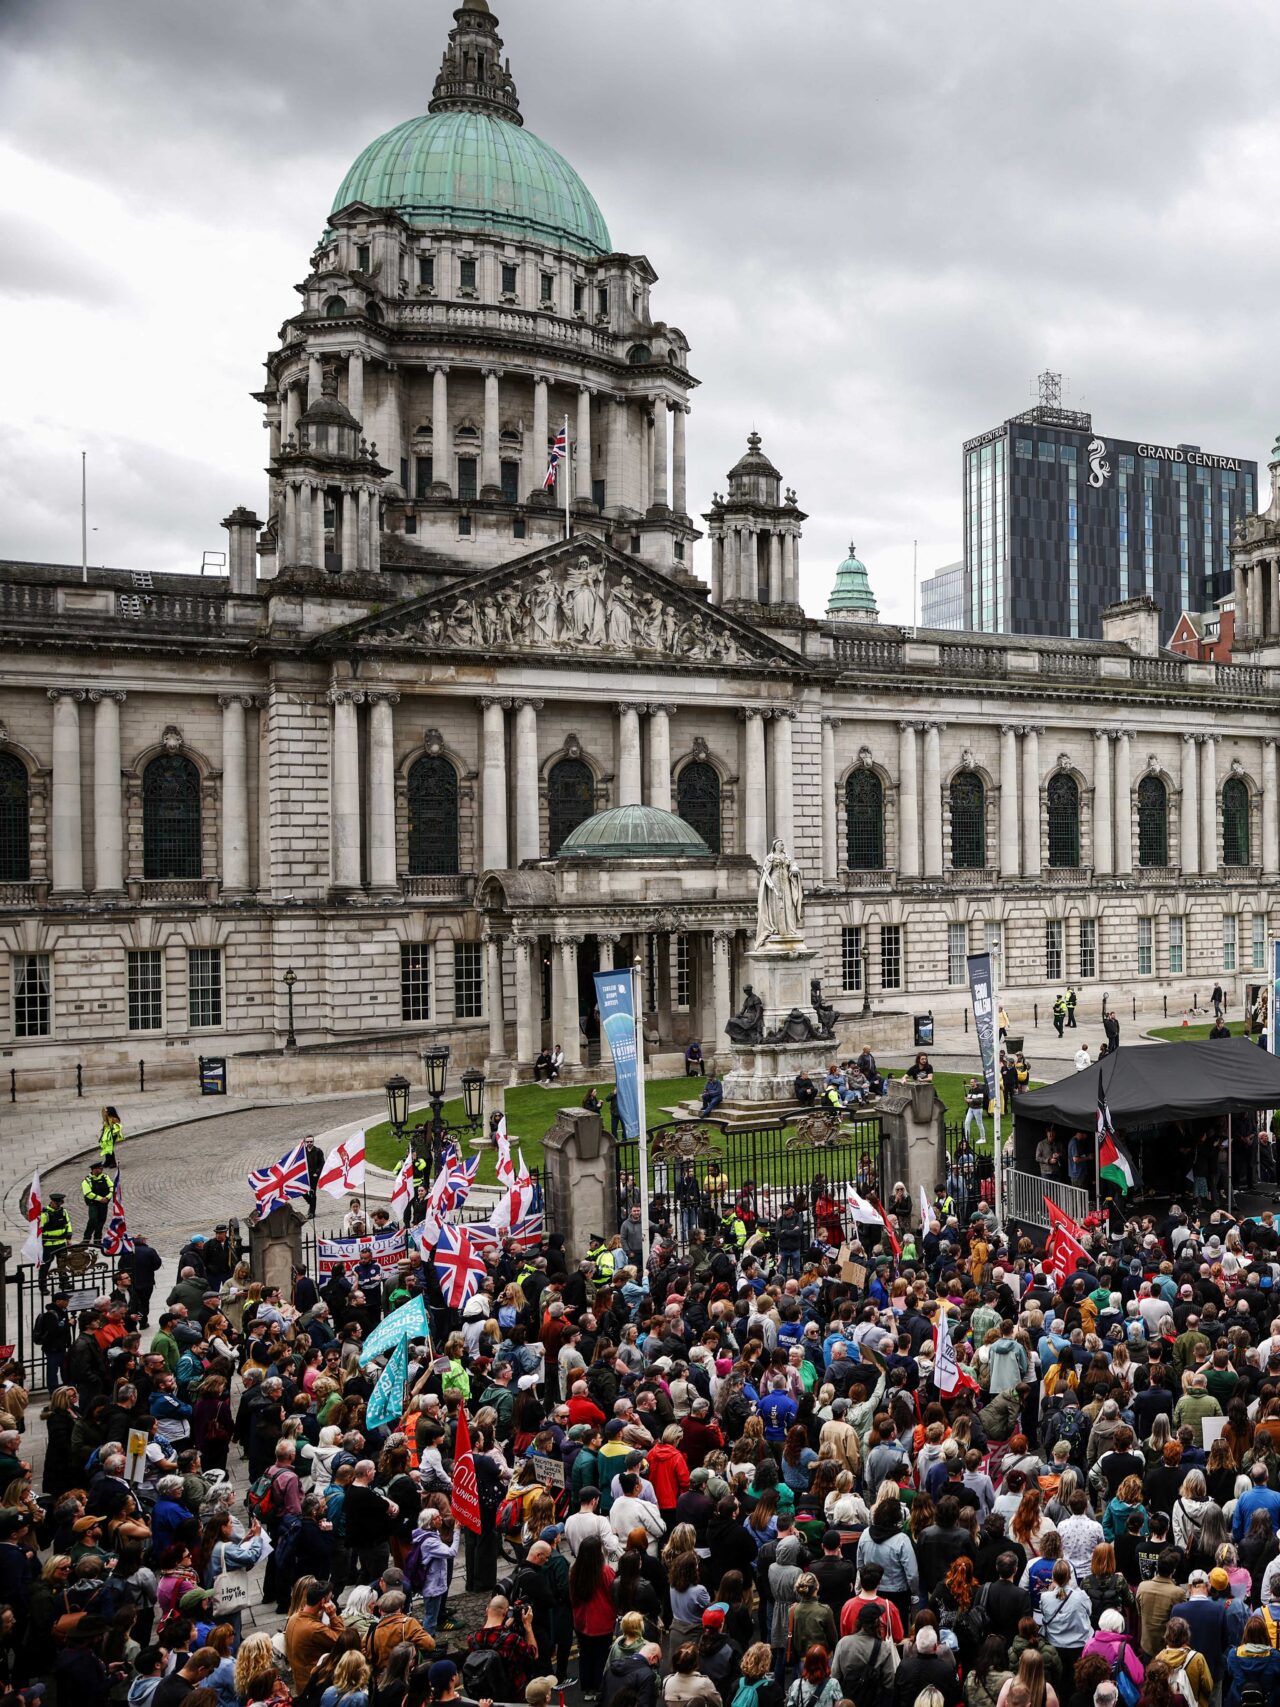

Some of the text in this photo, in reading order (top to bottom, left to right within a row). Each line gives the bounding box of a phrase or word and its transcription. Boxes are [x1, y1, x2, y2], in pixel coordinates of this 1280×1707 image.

[963, 427, 1006, 451] GRAND CENTRAL
[1137, 444, 1242, 471] GRAND CENTRAL
[323, 1236, 406, 1255] FLAG PROTEST
[322, 1260, 355, 1272] EVY
[456, 1487, 479, 1506] UNION
[226, 1586, 240, 1594] love
[235, 1590, 246, 1598] life
